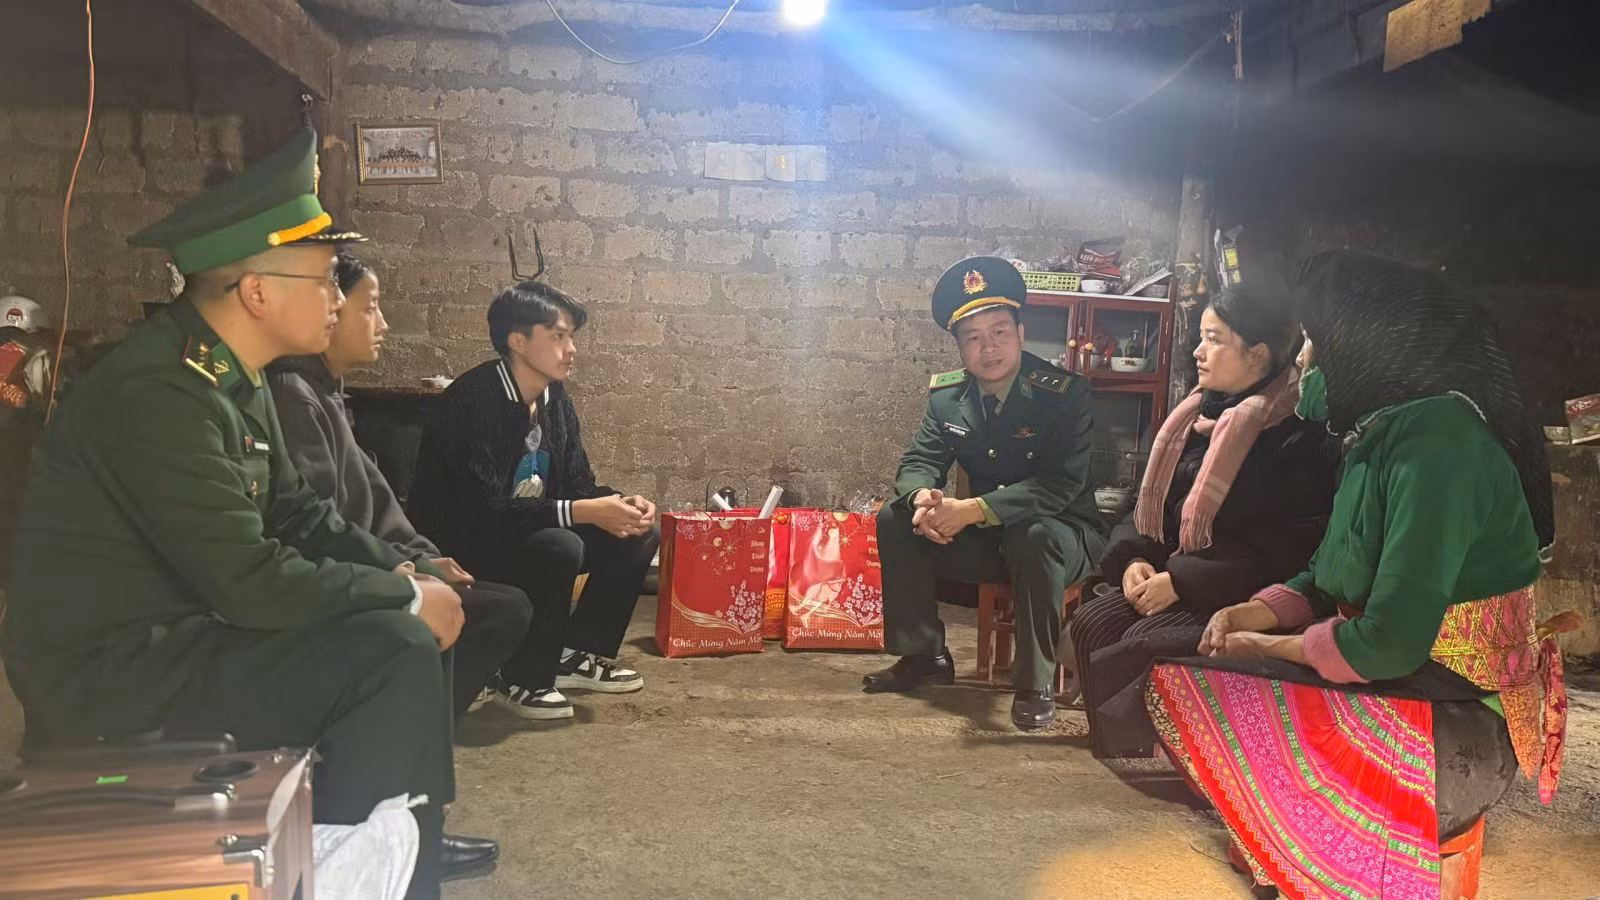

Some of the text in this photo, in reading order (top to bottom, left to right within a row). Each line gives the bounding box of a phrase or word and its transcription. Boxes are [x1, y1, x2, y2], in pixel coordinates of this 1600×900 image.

[791, 627, 815, 638] Chúc
[817, 628, 842, 640] Mừng
[844, 628, 866, 640] Năm
[673, 637, 697, 649] Chúc
[698, 638, 724, 650] Mừng
[725, 636, 746, 648] Năm
